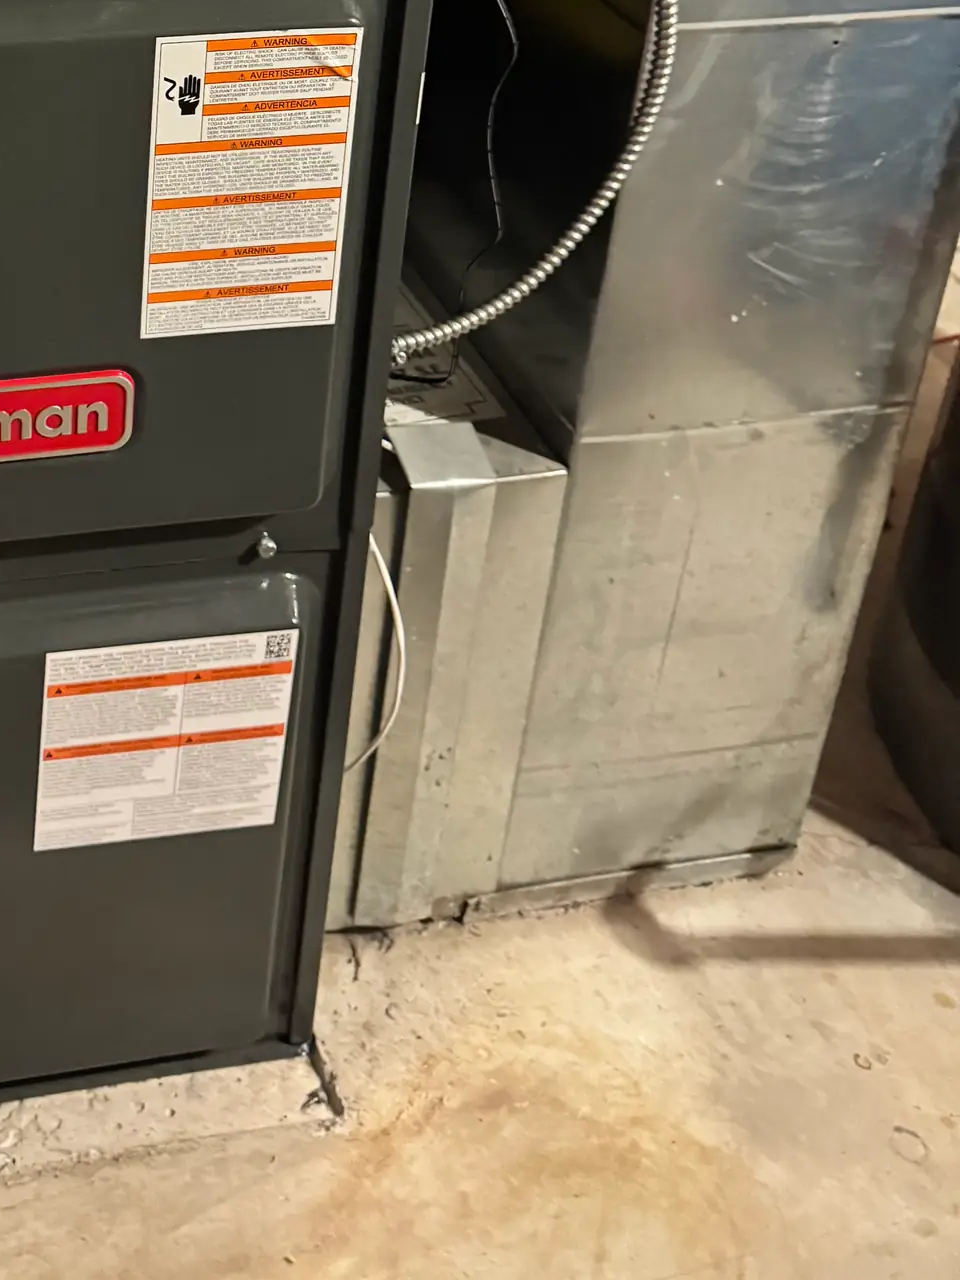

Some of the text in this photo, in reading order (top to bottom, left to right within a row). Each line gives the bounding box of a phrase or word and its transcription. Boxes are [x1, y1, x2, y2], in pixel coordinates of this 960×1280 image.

[263, 37, 308, 46] WARNING
[250, 68, 325, 79] AVERTISSEMENT
[254, 100, 318, 110] ADVERTENCIA
[240, 139, 283, 148] WARNING
[223, 192, 297, 204] AVERTISSEMENT
[234, 246, 276, 256] WARNING
[216, 284, 289, 296] AVERTISSEMENT
